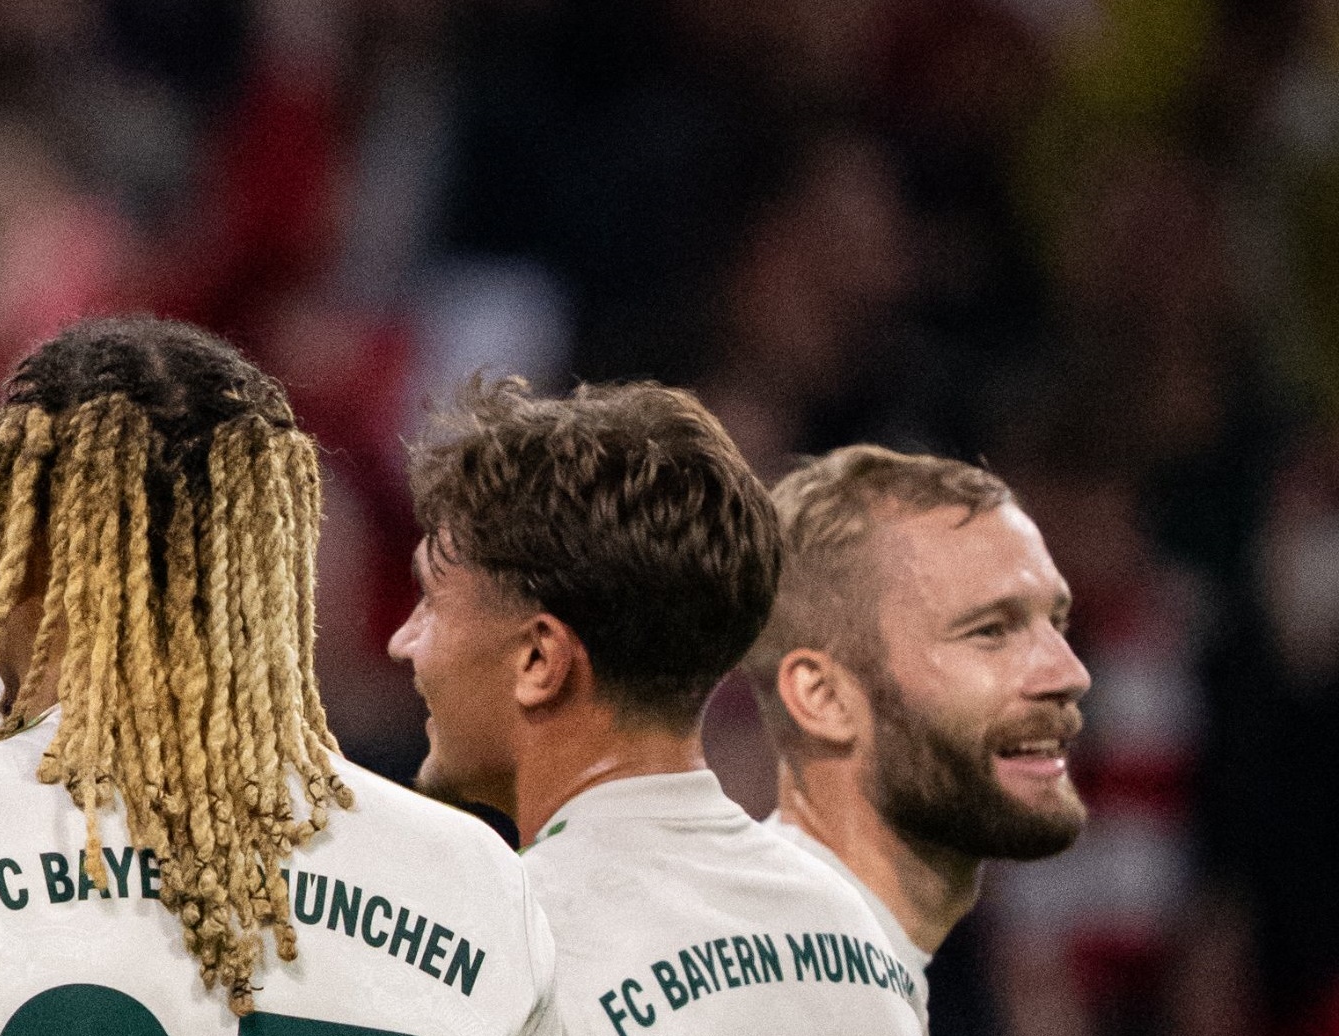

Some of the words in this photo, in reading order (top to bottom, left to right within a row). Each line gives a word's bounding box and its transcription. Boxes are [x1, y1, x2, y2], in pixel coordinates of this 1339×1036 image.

[39, 847, 162, 904] BAYE
[279, 866, 486, 997] ÜNCHEN
[651, 933, 784, 1012] BAYERN
